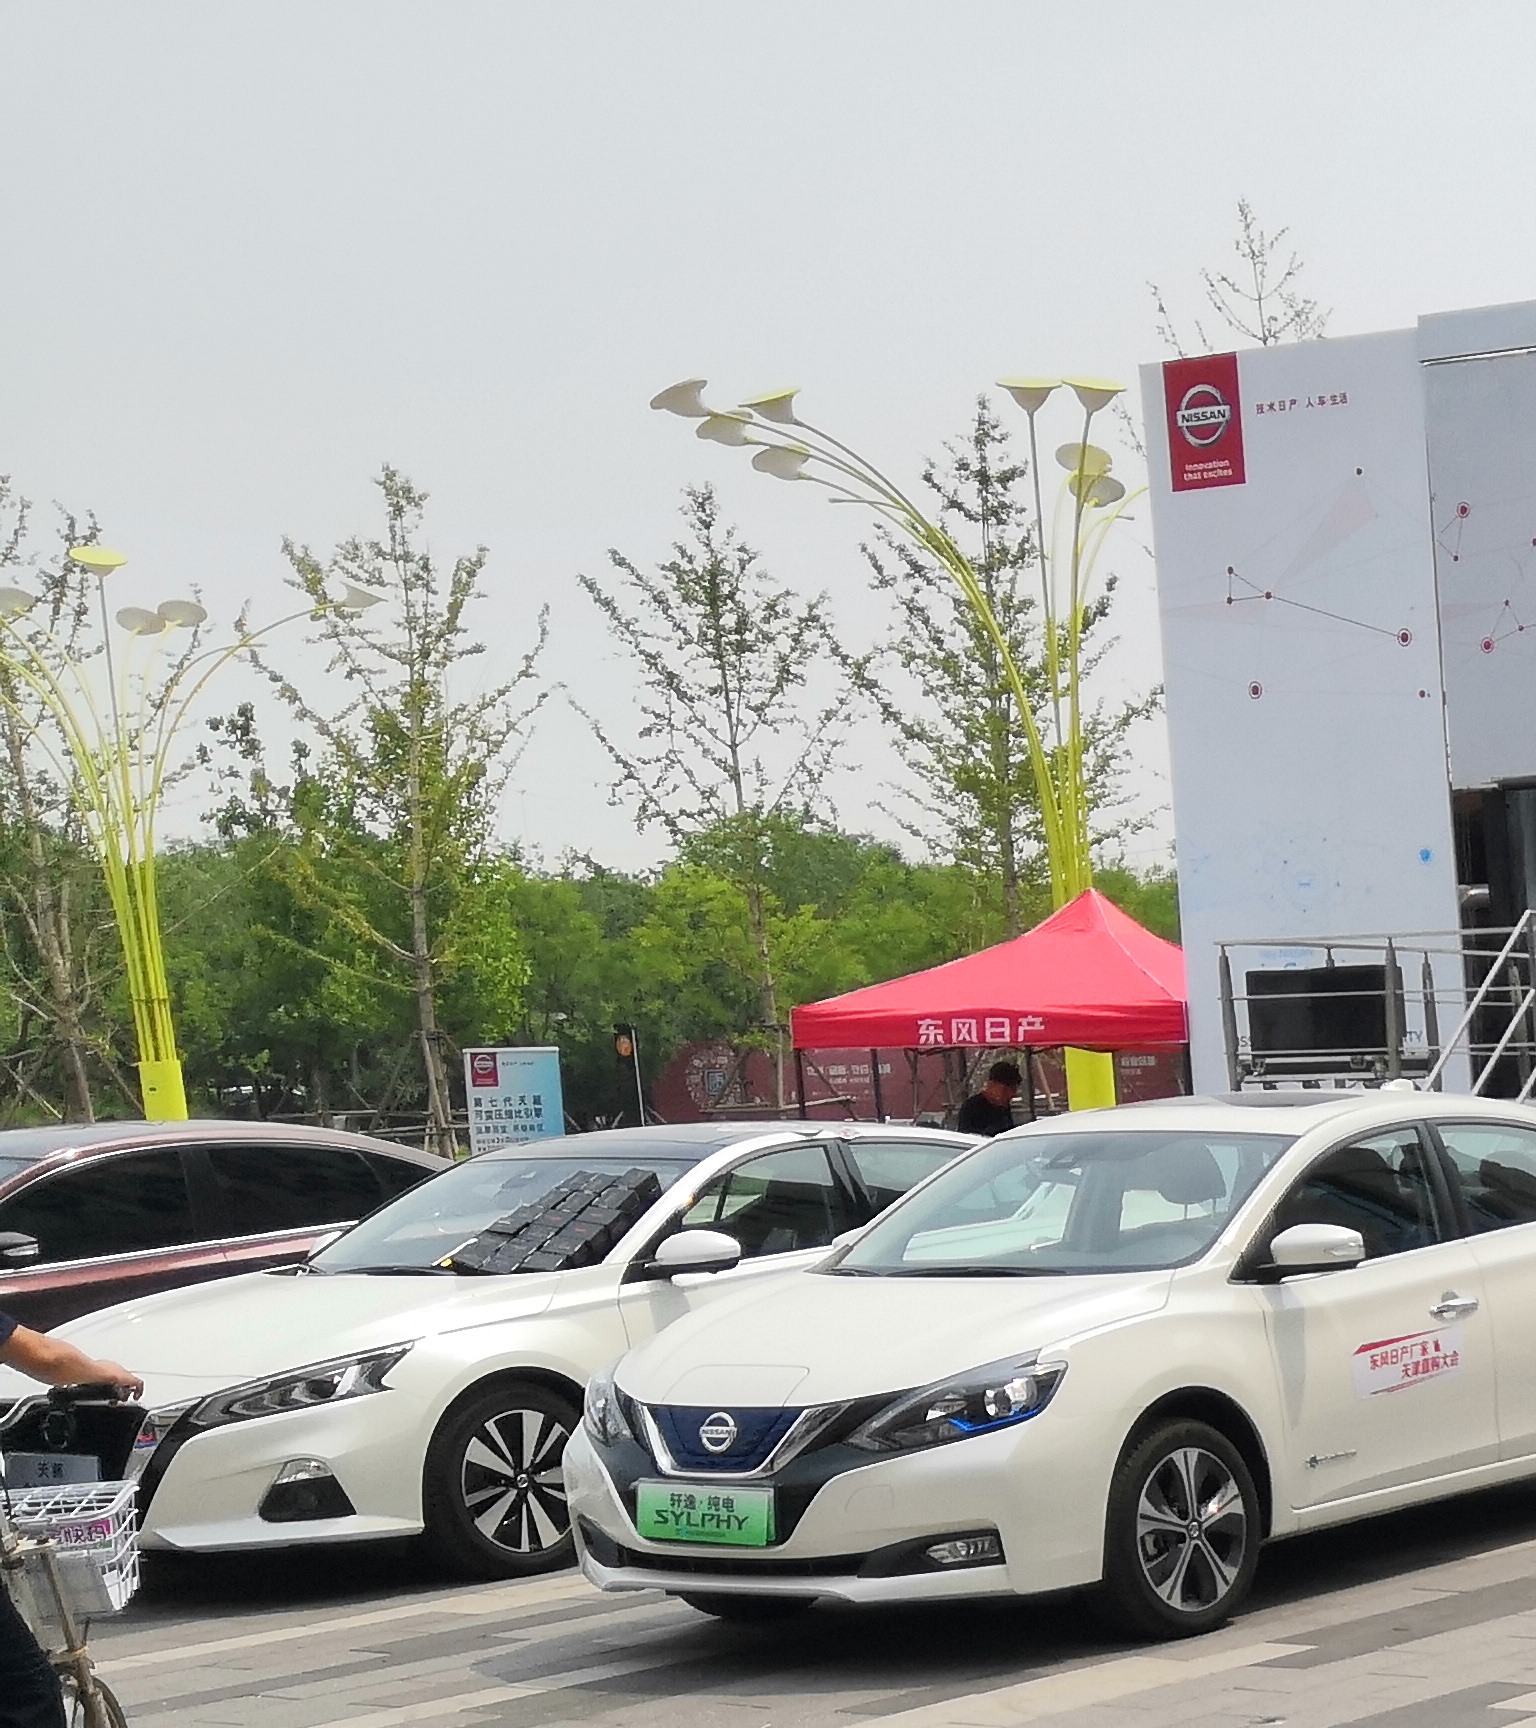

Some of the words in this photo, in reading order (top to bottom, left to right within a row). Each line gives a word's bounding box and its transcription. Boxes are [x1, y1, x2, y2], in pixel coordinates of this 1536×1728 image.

[1181, 408, 1227, 424] NISSAN
[917, 1015, 1045, 1044] 东风日产
[702, 1427, 731, 1437] NISSAN
[653, 1508, 750, 1532] SYLPHY
